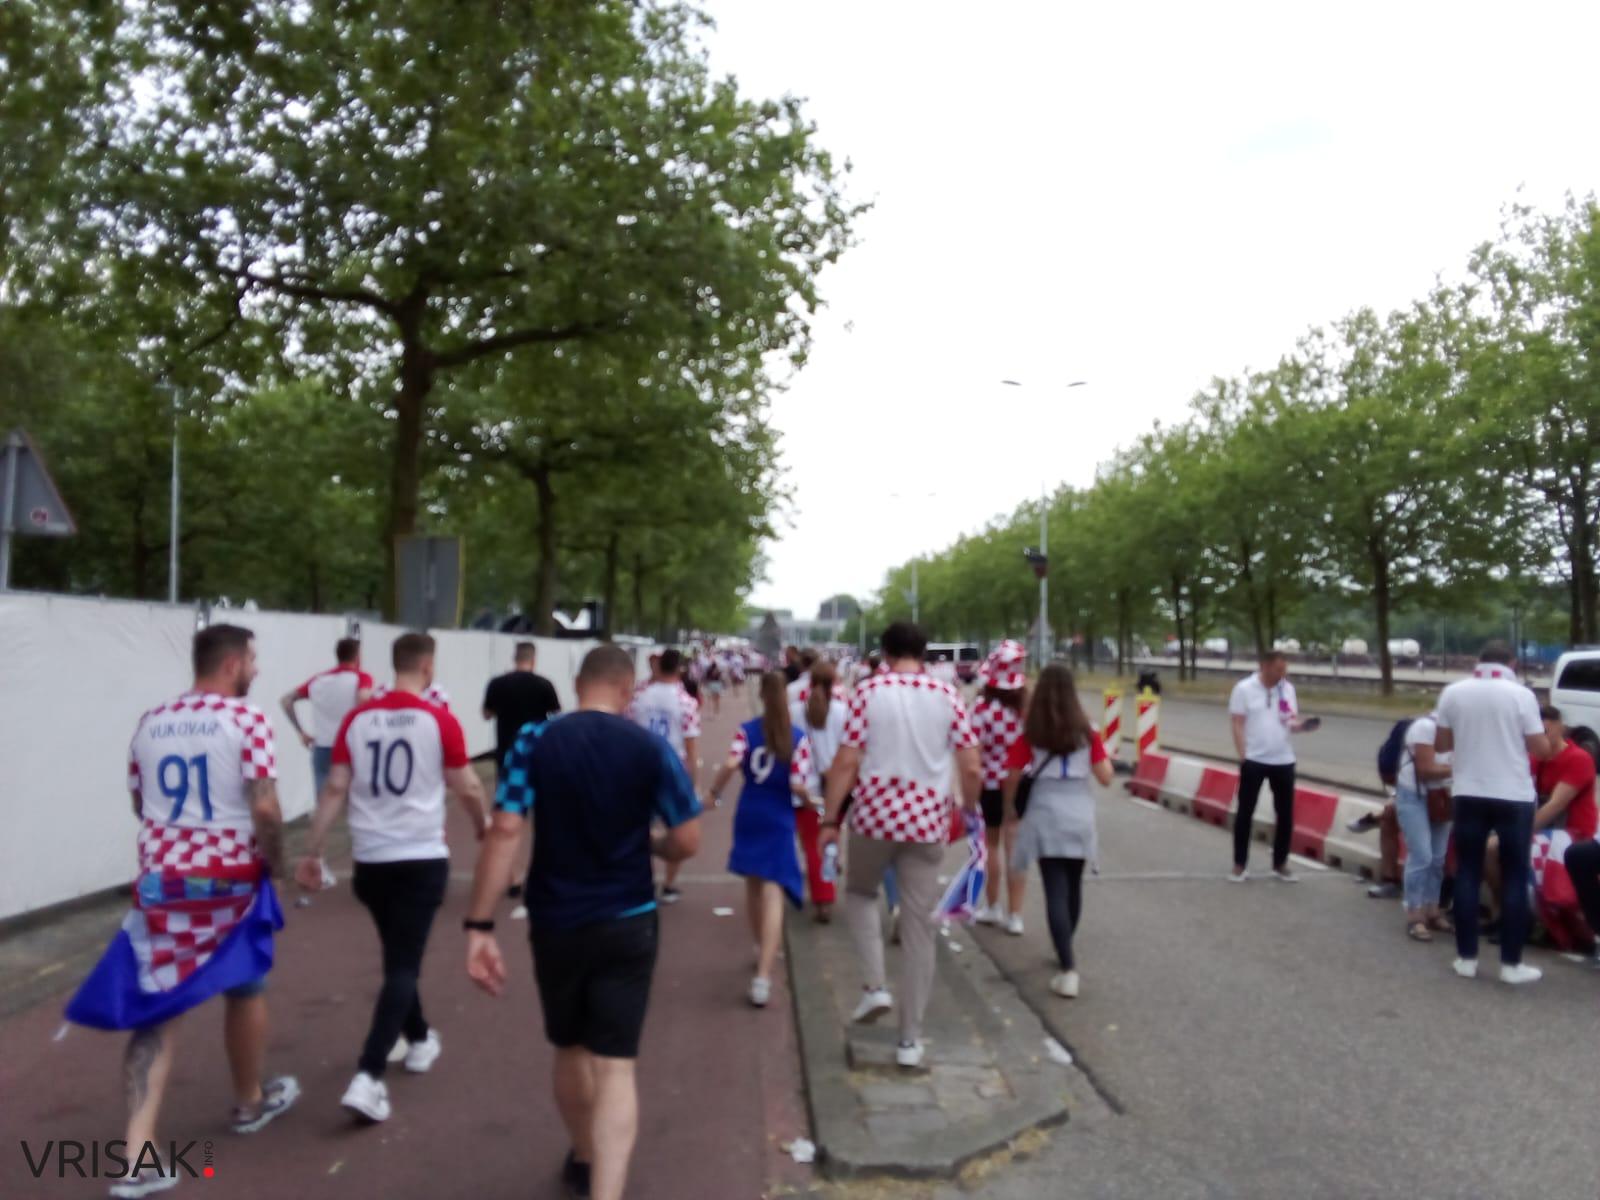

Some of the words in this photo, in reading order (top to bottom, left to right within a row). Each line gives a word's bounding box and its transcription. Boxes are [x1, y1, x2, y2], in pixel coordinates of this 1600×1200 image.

[149, 721, 219, 738] VUKOVAR
[157, 753, 213, 822] 91
[366, 738, 413, 797] 10
[750, 745, 775, 784] 9
